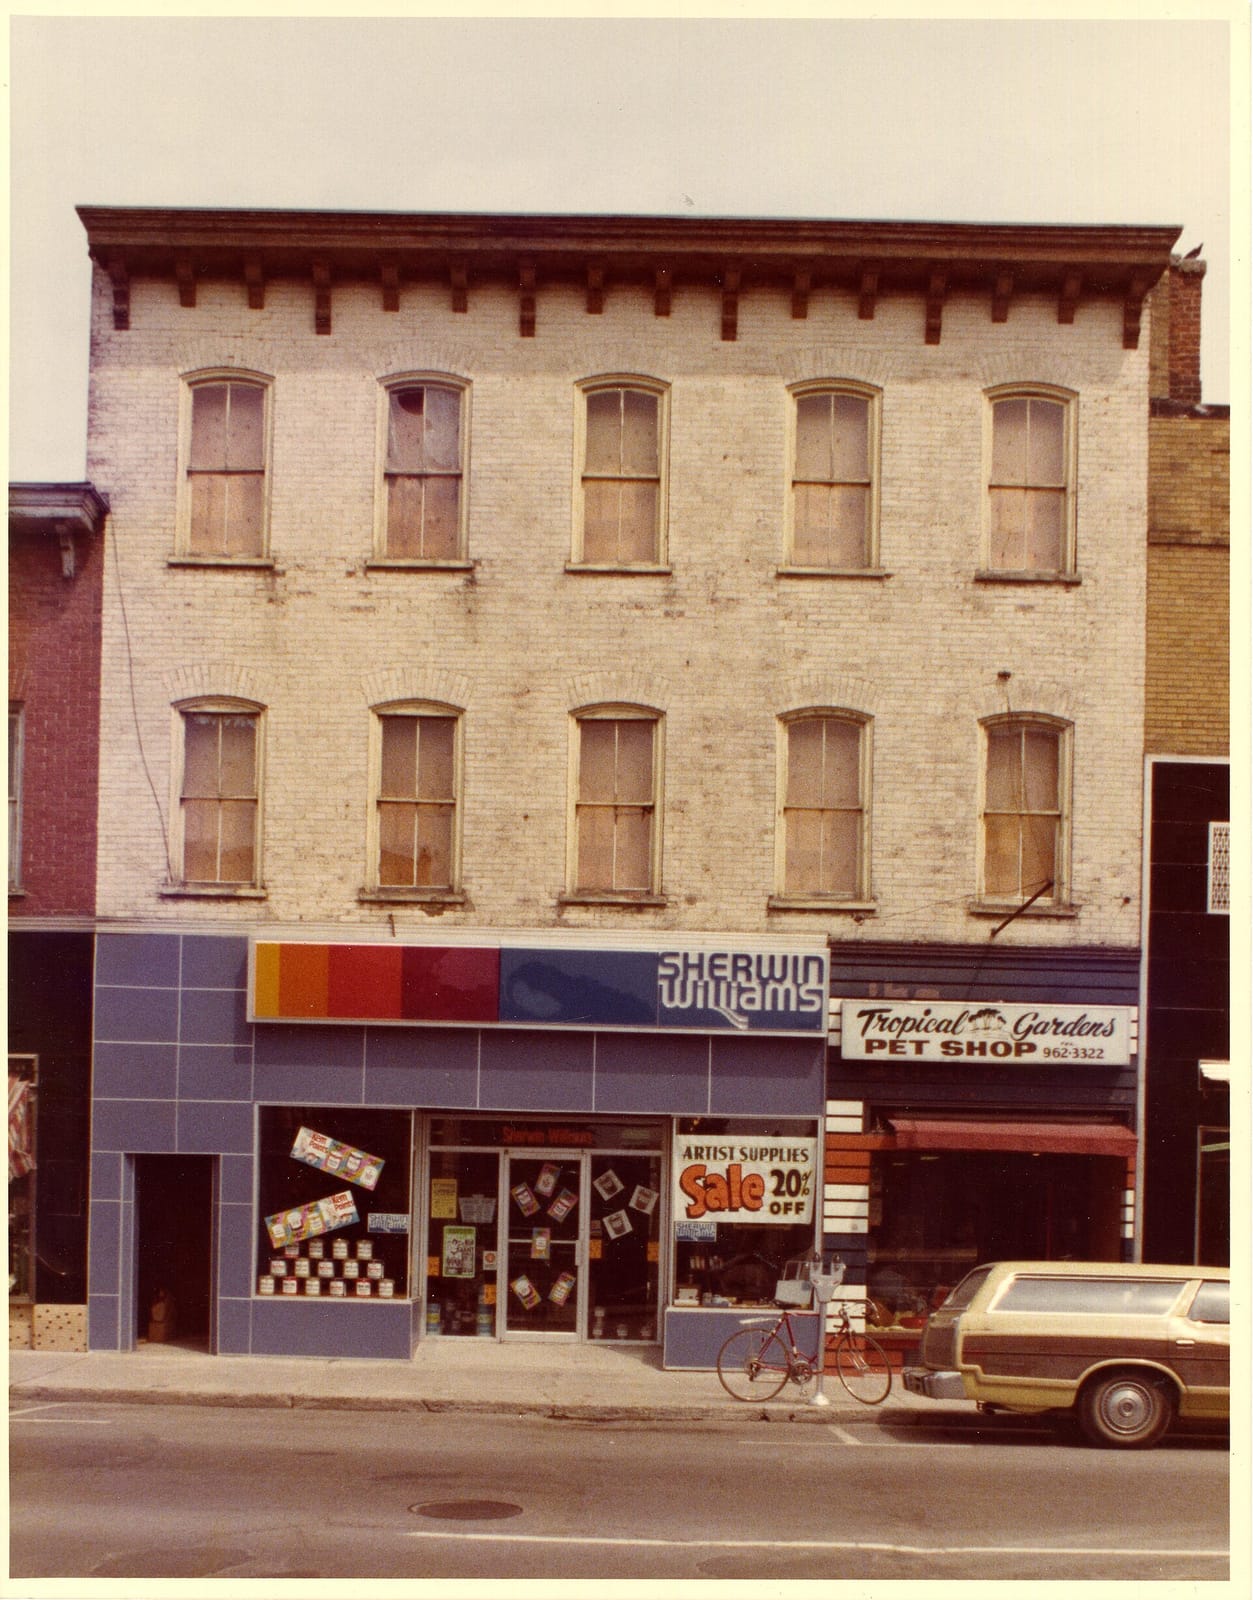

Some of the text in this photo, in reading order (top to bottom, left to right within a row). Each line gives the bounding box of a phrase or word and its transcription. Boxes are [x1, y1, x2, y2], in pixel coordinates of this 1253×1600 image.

[658, 951, 824, 985] SHERWIN
[856, 1007, 1116, 1041] Tropical Gardens
[865, 1038, 1037, 1058] PET SHOP
[683, 1146, 809, 1162] ARTIST SUPPLIES
[679, 1163, 765, 1219] Sale
[770, 1168, 813, 1198] 20%
[769, 1202, 805, 1215] OFF
